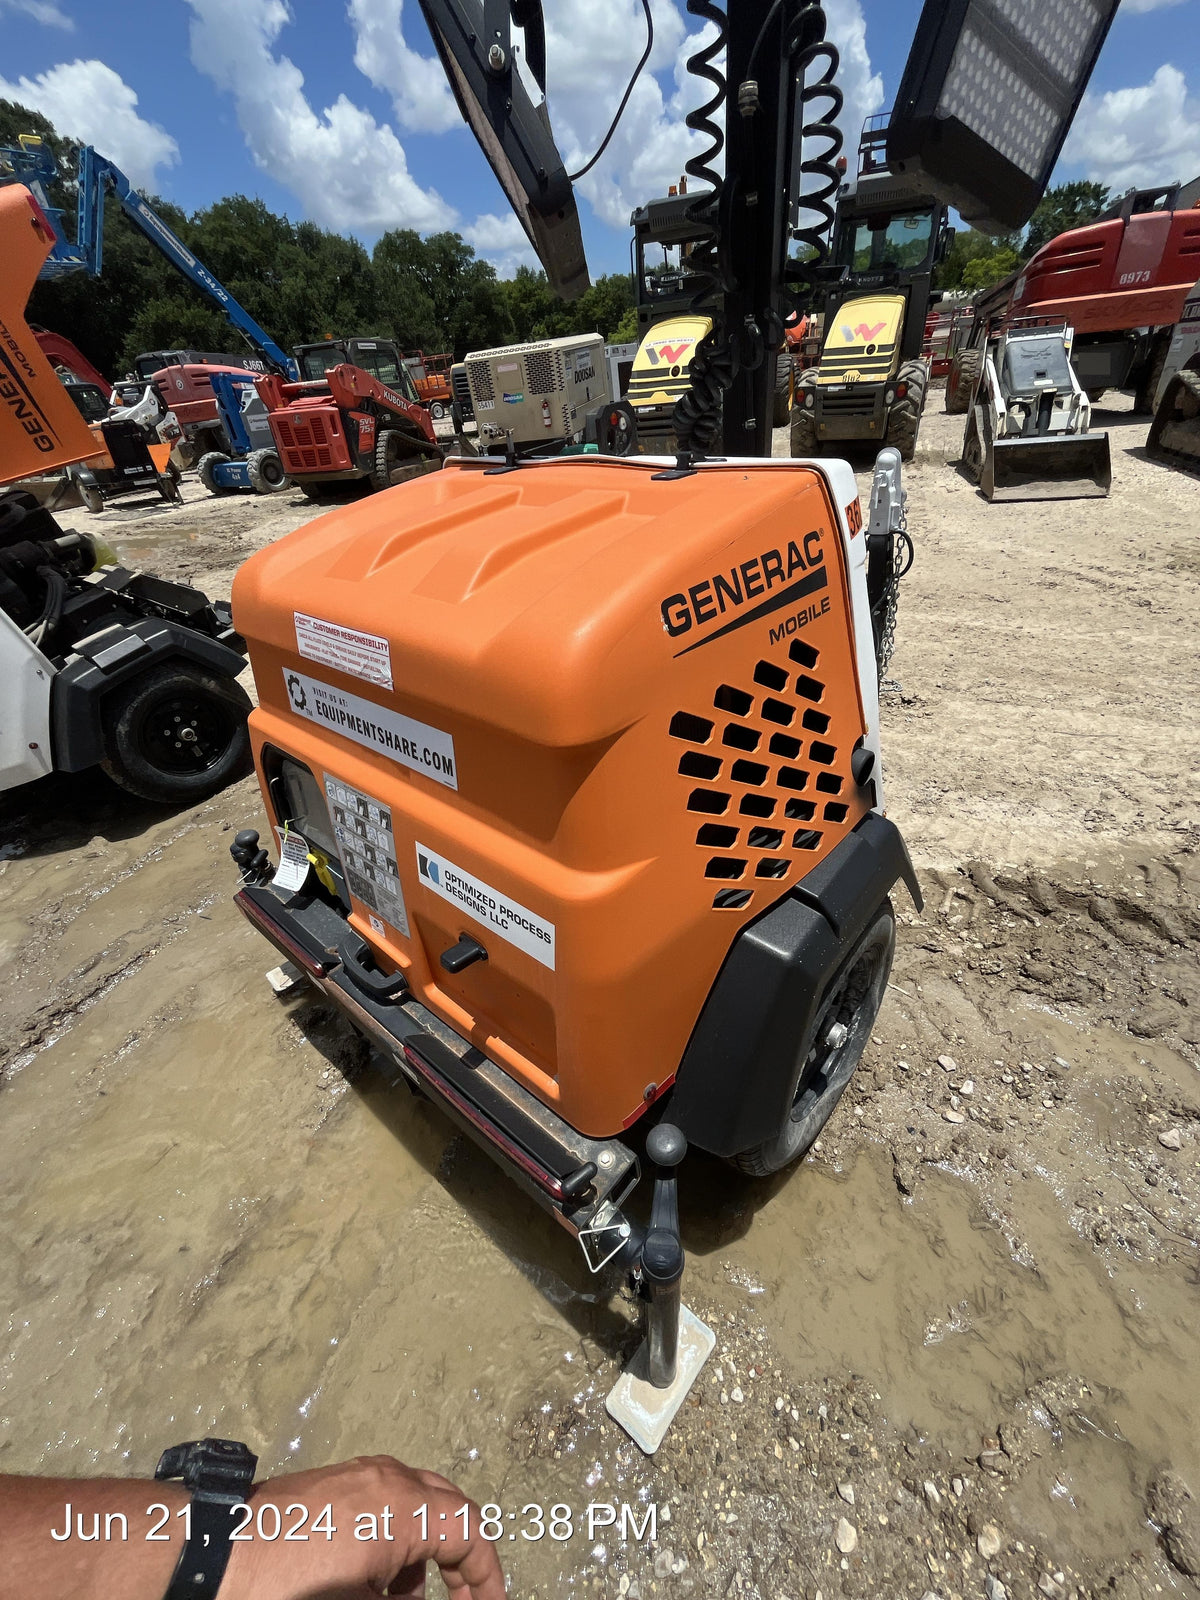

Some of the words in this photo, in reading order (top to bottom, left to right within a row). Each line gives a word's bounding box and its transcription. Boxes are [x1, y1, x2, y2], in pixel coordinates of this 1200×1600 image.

[197, 269, 229, 302] Z-34/22
[1119, 270, 1151, 285] 8973
[574, 365, 596, 384] DOOSAN
[0, 369, 55, 453] GENE
[383, 389, 408, 411] KUBOTA
[478, 400, 495, 411] 55411
[359, 417, 375, 426] SVL
[661, 530, 824, 638] GENERAC
[313, 621, 340, 638] CUSTOMER
[341, 629, 388, 652] RESPONSIBILITY
[769, 596, 831, 646] MOBILE
[312, 687, 327, 699] VISIT
[329, 694, 337, 703] US
[316, 699, 454, 777] EQUIPMENTSHARE.COM
[444, 870, 496, 910] OPTIMIZED
[499, 904, 552, 945] PROCESS
[445, 882, 487, 917] DESIGNS
[490, 912, 509, 930] LLC
